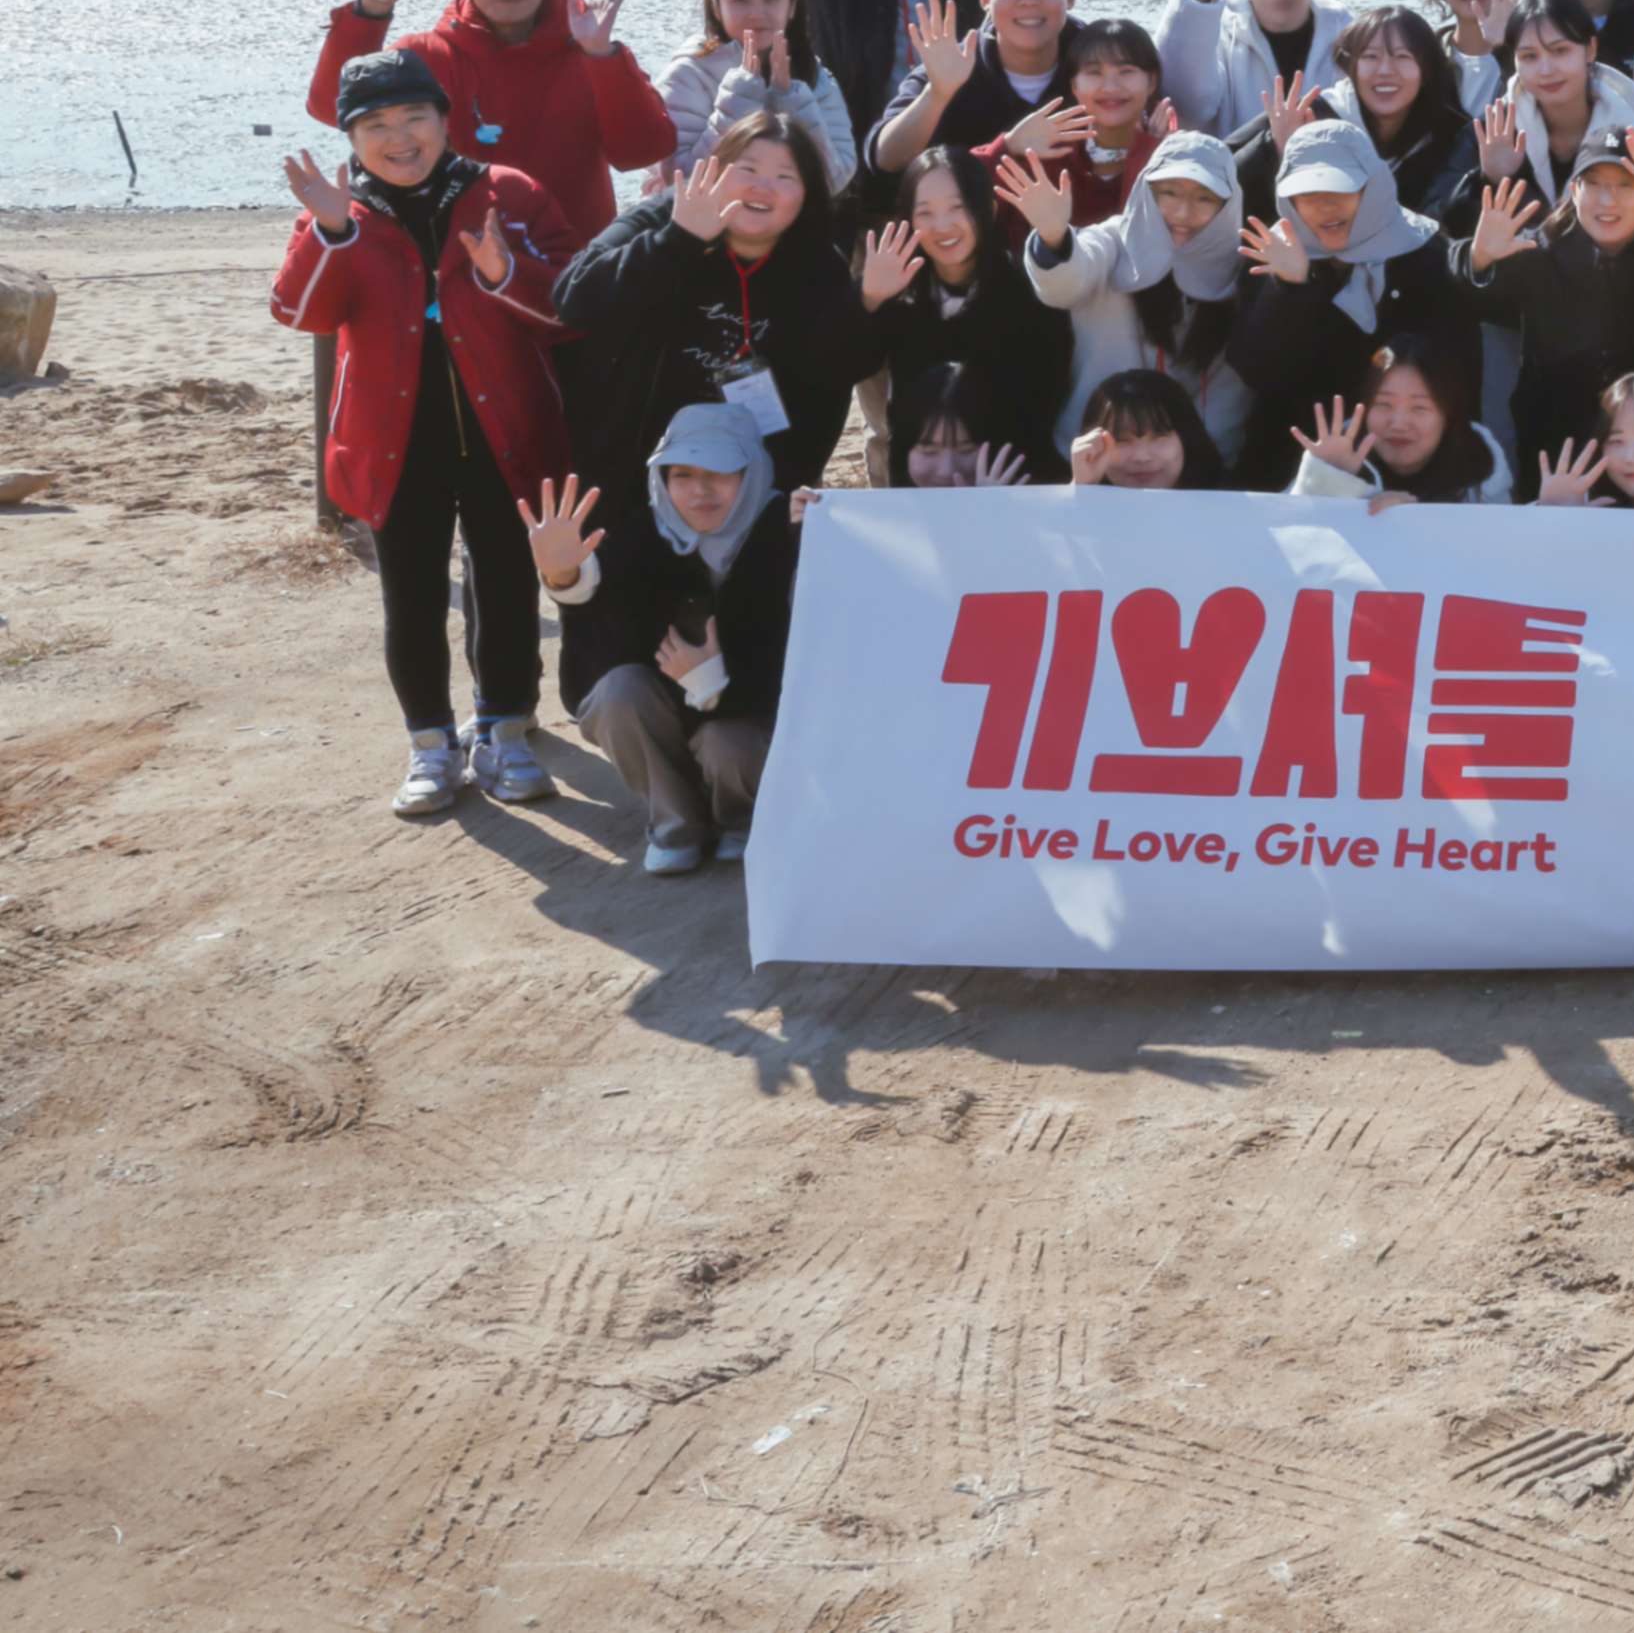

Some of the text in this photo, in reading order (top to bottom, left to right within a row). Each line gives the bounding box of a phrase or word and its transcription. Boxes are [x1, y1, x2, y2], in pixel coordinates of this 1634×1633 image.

[952, 813, 1557, 873] Give Love, Give Heart
